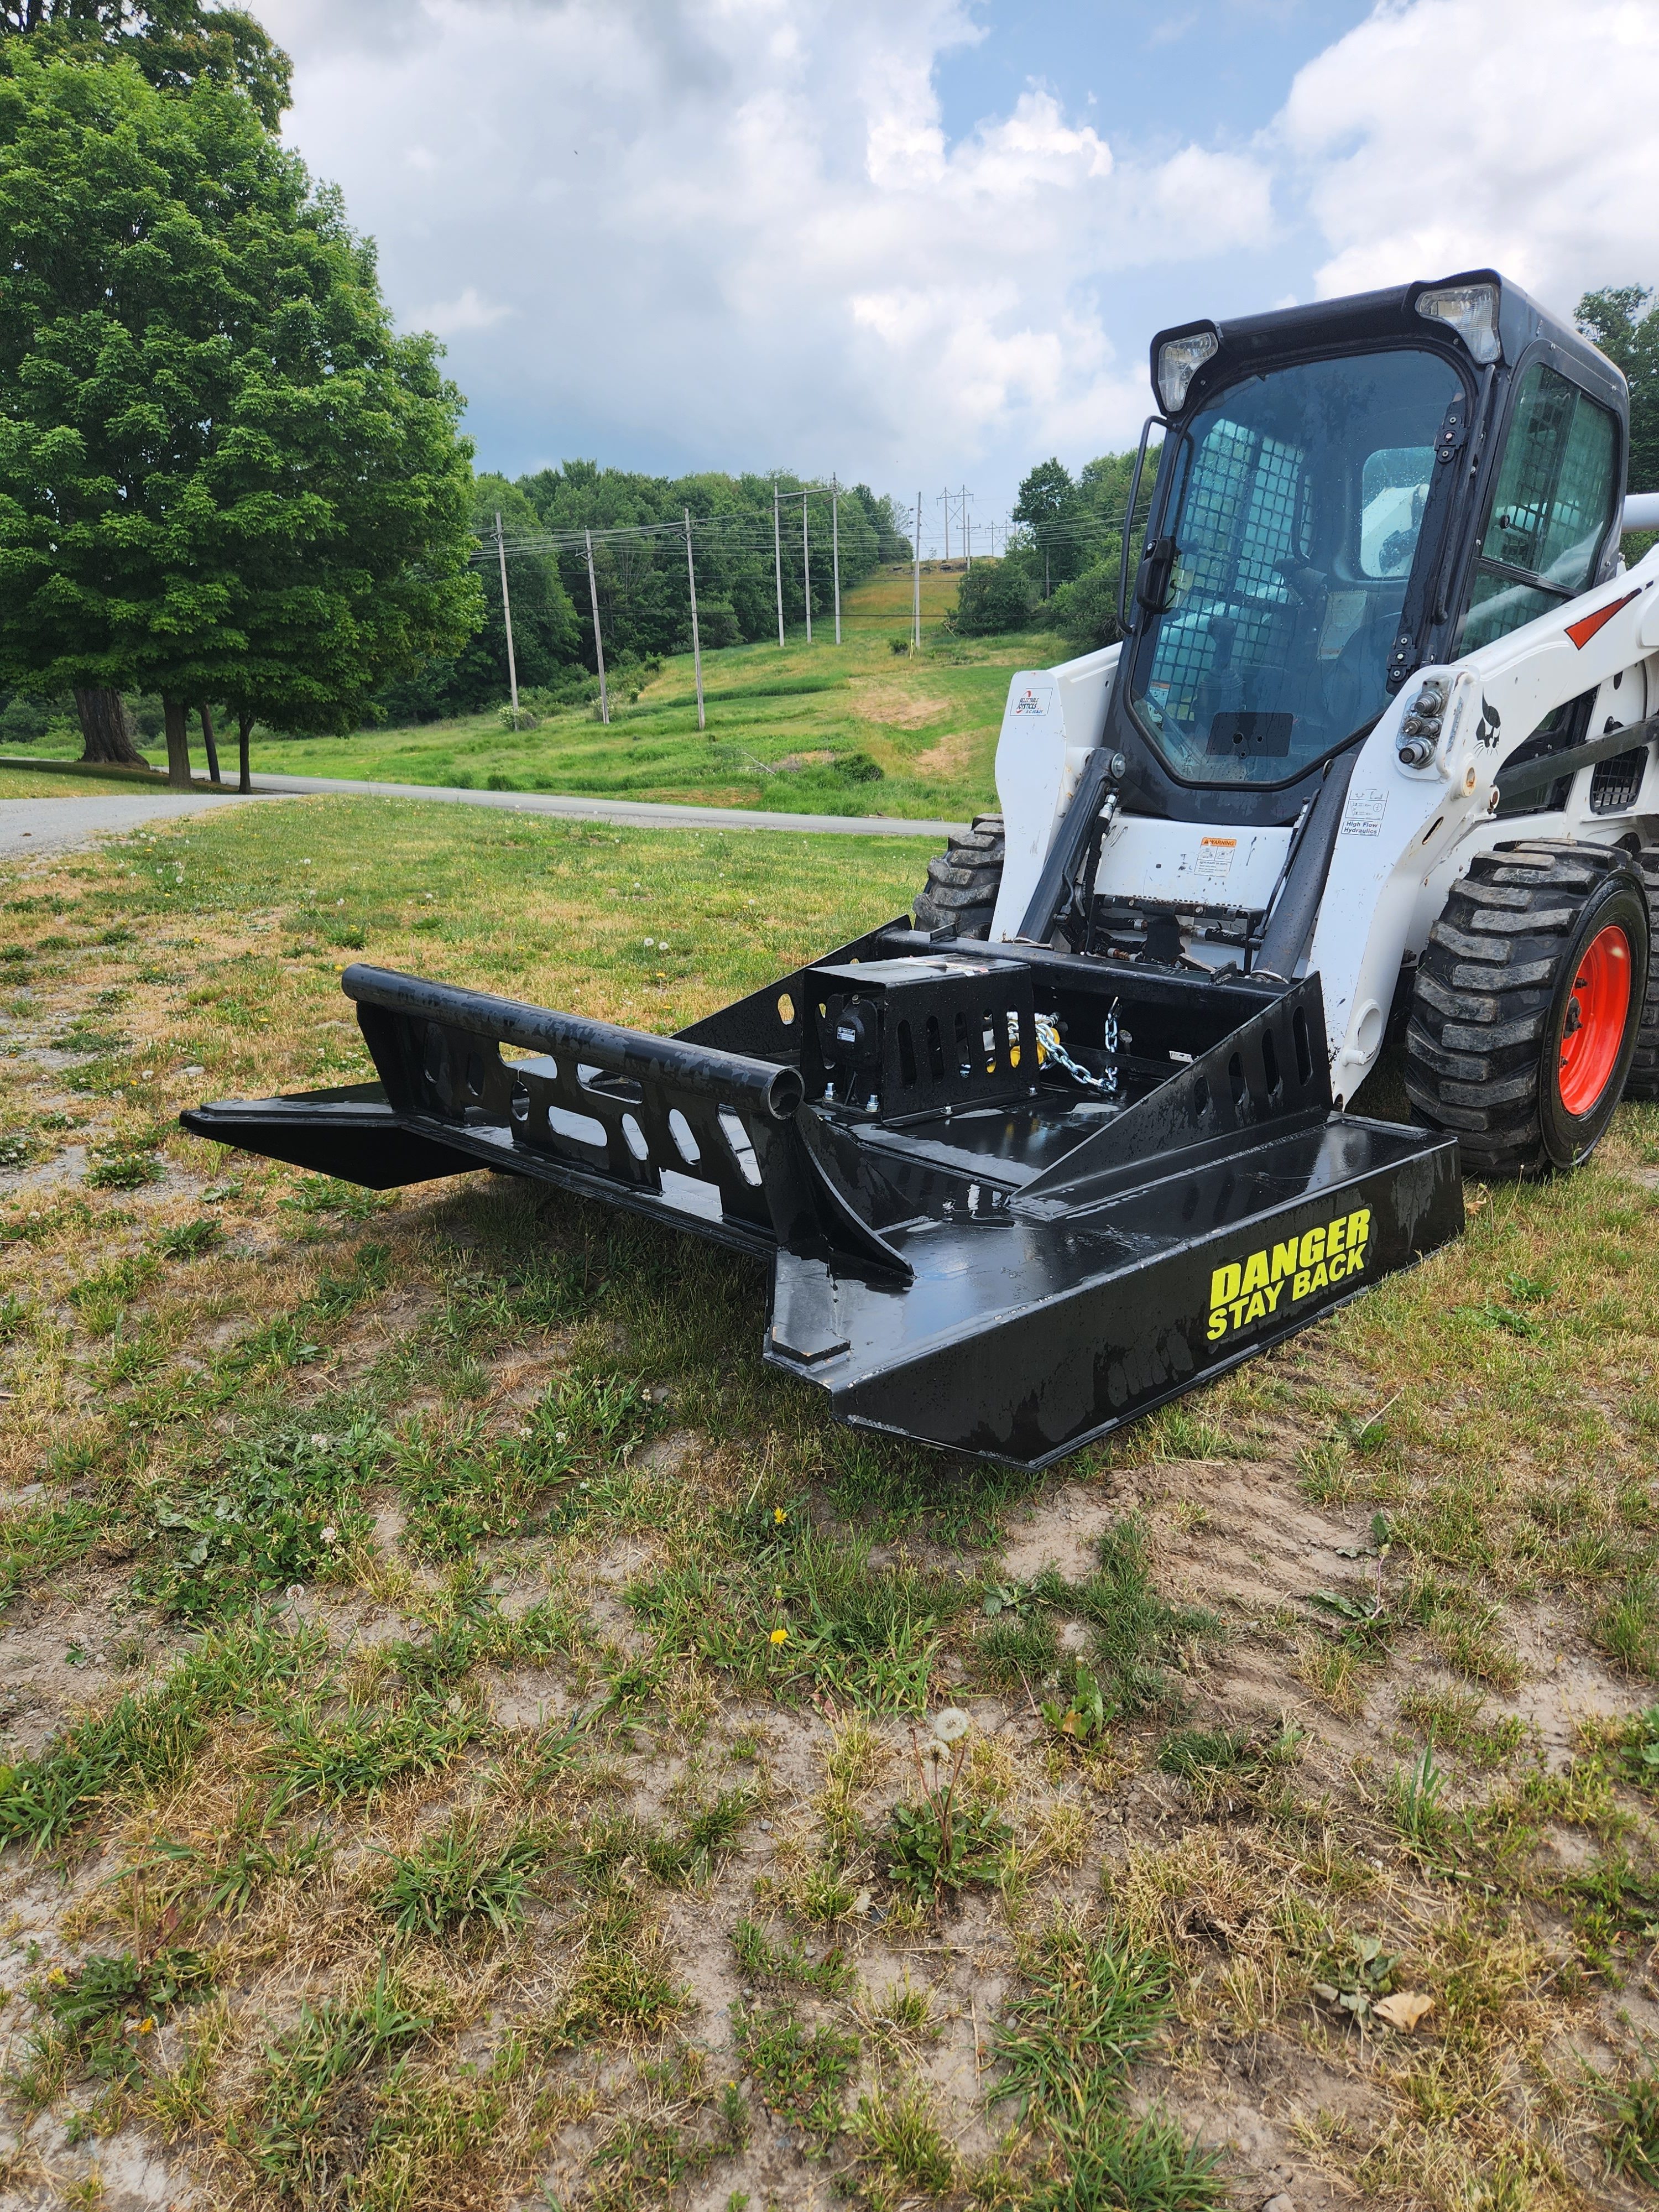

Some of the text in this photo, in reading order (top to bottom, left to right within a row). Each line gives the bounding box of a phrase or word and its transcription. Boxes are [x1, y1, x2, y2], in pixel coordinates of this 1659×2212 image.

[1207, 1243, 1366, 1340] STAY BACK
[1211, 1209, 1370, 1310] DANGER
